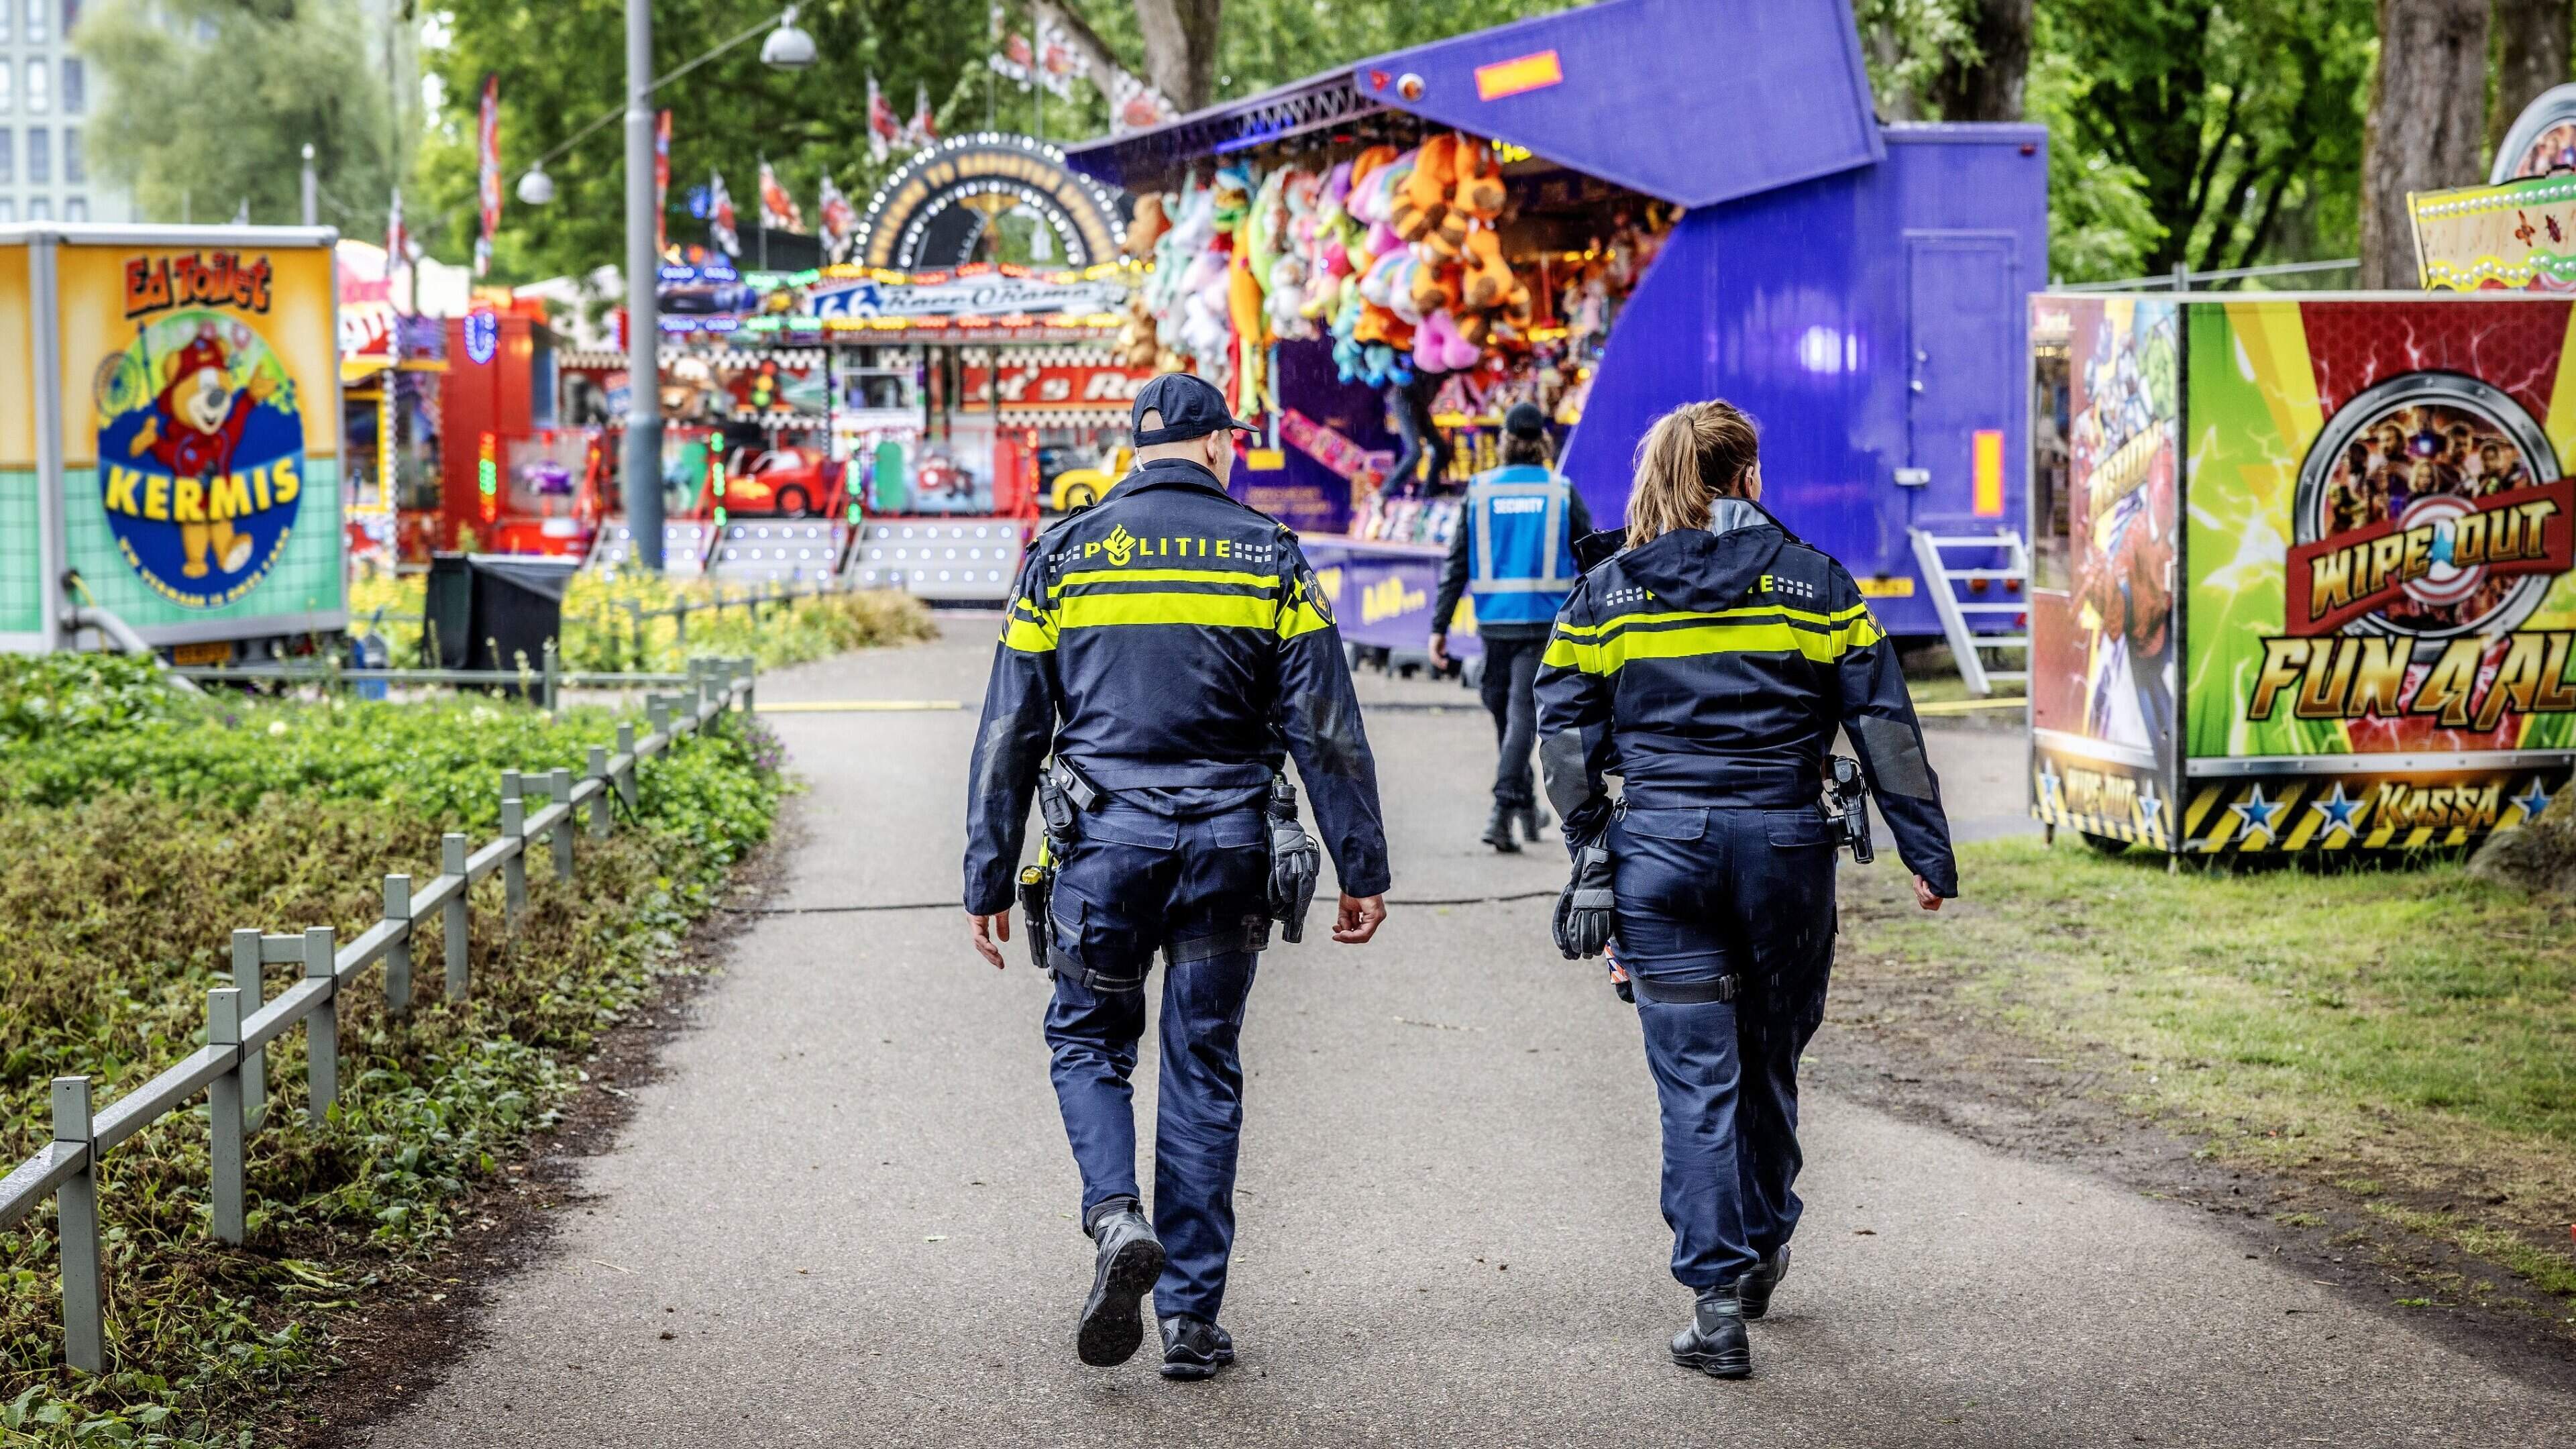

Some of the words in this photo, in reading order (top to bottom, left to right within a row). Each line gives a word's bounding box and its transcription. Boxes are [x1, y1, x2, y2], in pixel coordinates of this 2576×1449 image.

[125, 256, 173, 319] Ed
[174, 252, 272, 314] Toilet
[105, 458, 301, 522] KERMIS
[1493, 497, 1545, 515] SECURITY
[1084, 524, 1231, 566] POLITIE
[2311, 525, 2435, 621] WIPE
[2453, 499, 2559, 568] OUT
[2247, 635, 2415, 720] FUN
[2412, 633, 2486, 727] 4
[2373, 782, 2501, 832] KASSA
